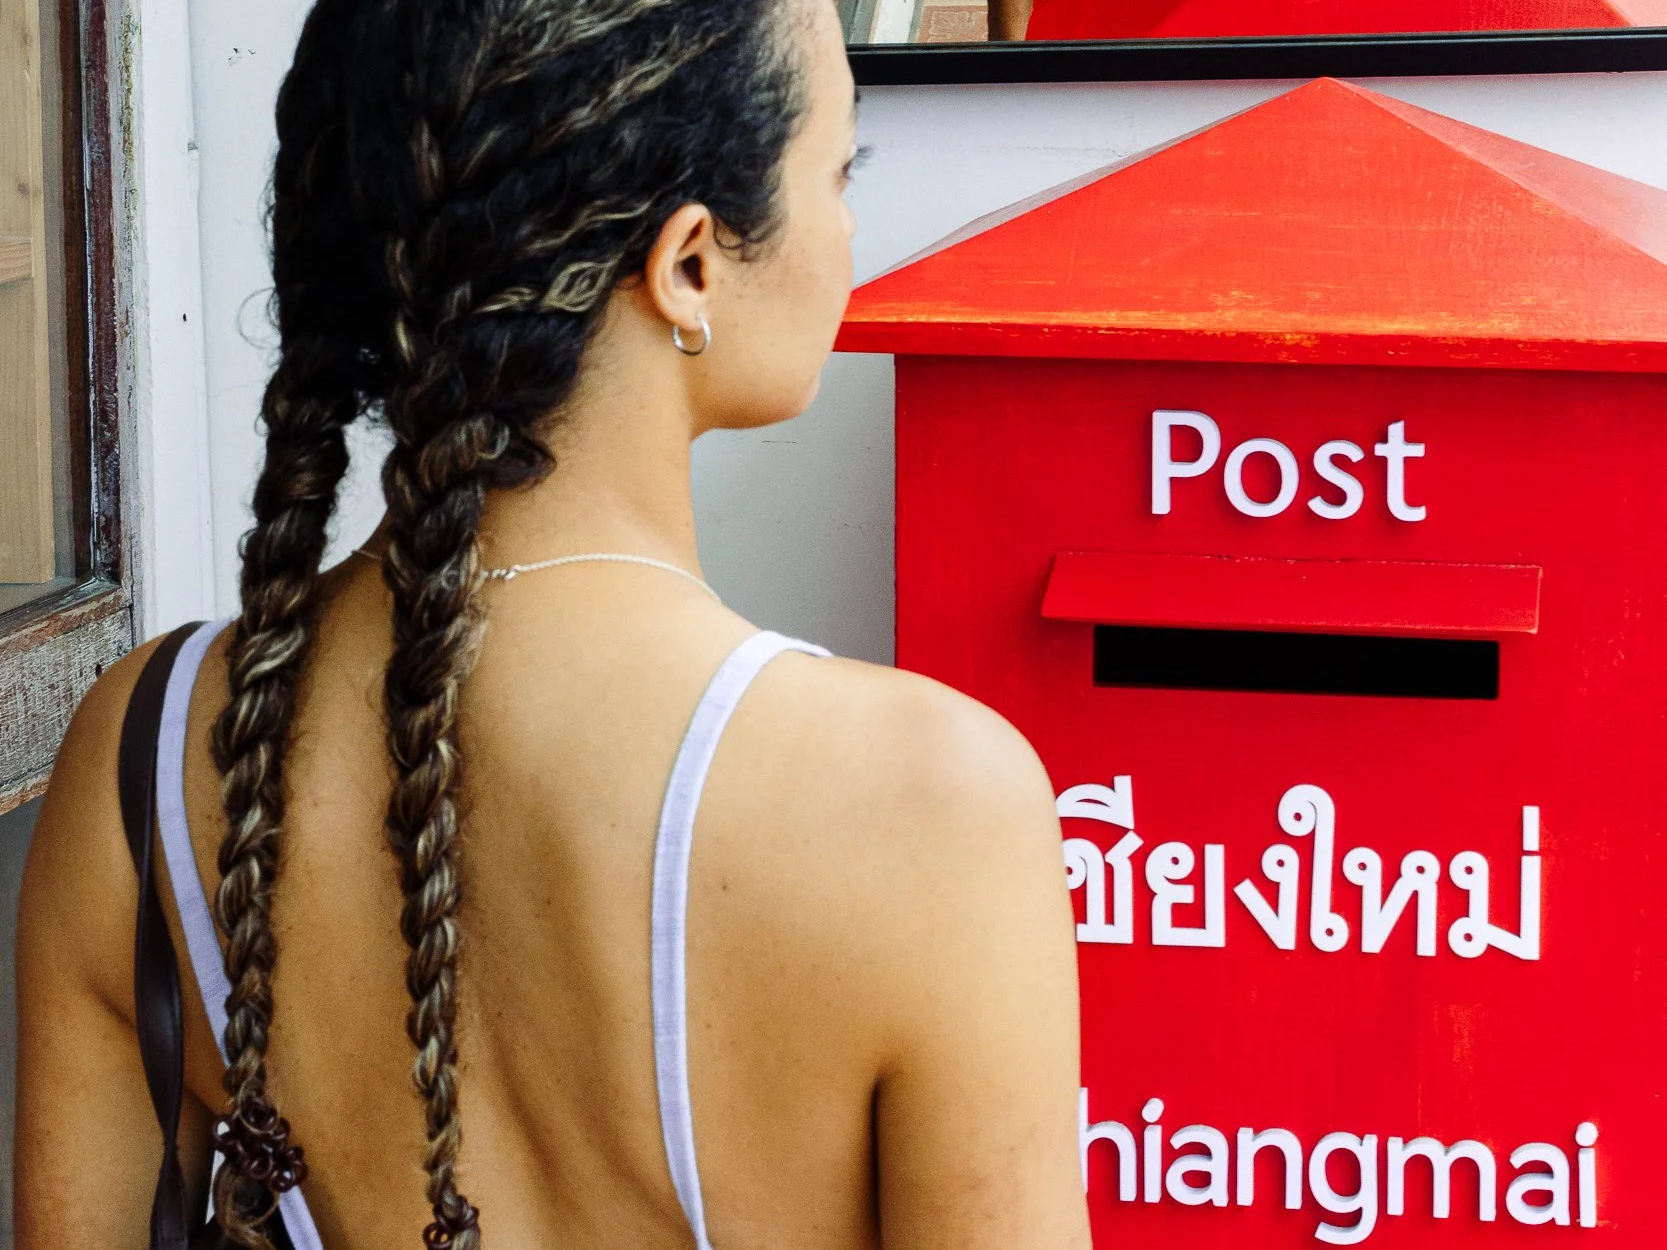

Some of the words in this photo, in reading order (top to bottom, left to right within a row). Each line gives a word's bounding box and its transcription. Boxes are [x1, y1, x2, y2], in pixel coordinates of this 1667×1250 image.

[1150, 409, 1428, 522] Post
[1055, 774, 1541, 961] ชียงใหม่
[1078, 1086, 1599, 1246] hiangmai
